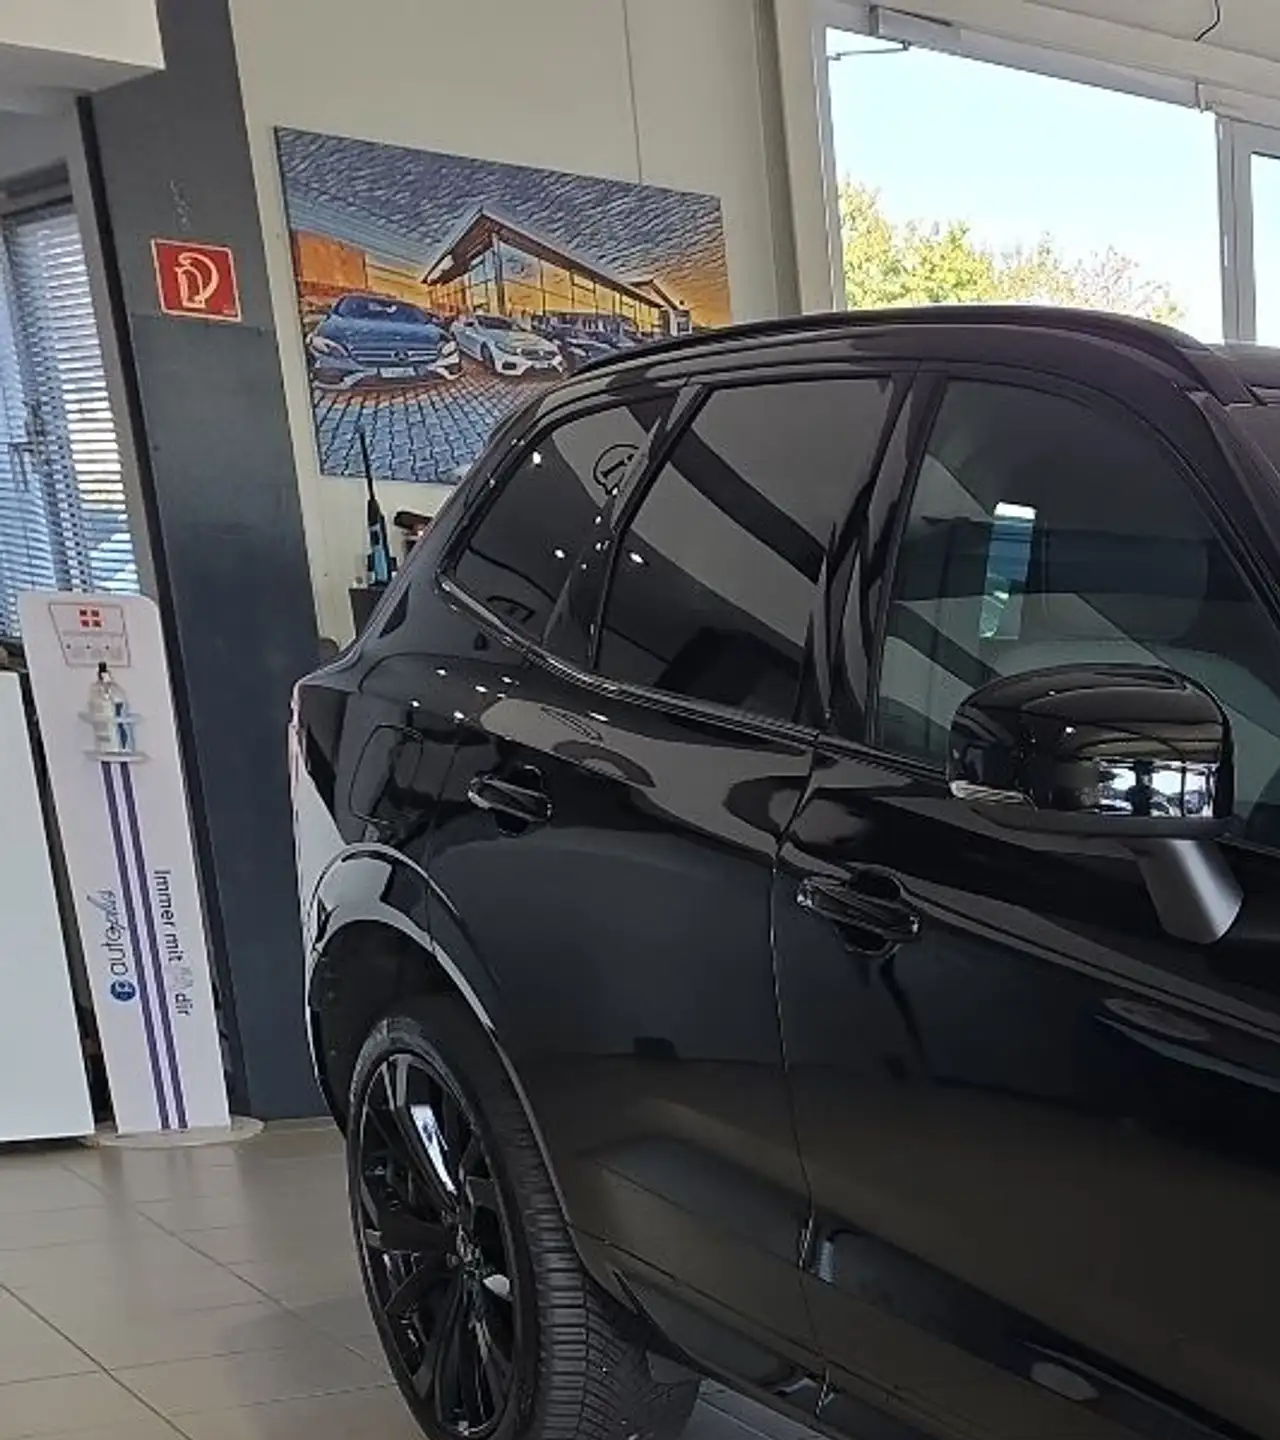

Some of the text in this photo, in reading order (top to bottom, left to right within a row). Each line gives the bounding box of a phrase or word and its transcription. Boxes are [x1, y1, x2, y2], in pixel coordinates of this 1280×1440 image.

[153, 869, 176, 928] Immer
[163, 932, 184, 963] mit
[175, 992, 194, 1017] dir
